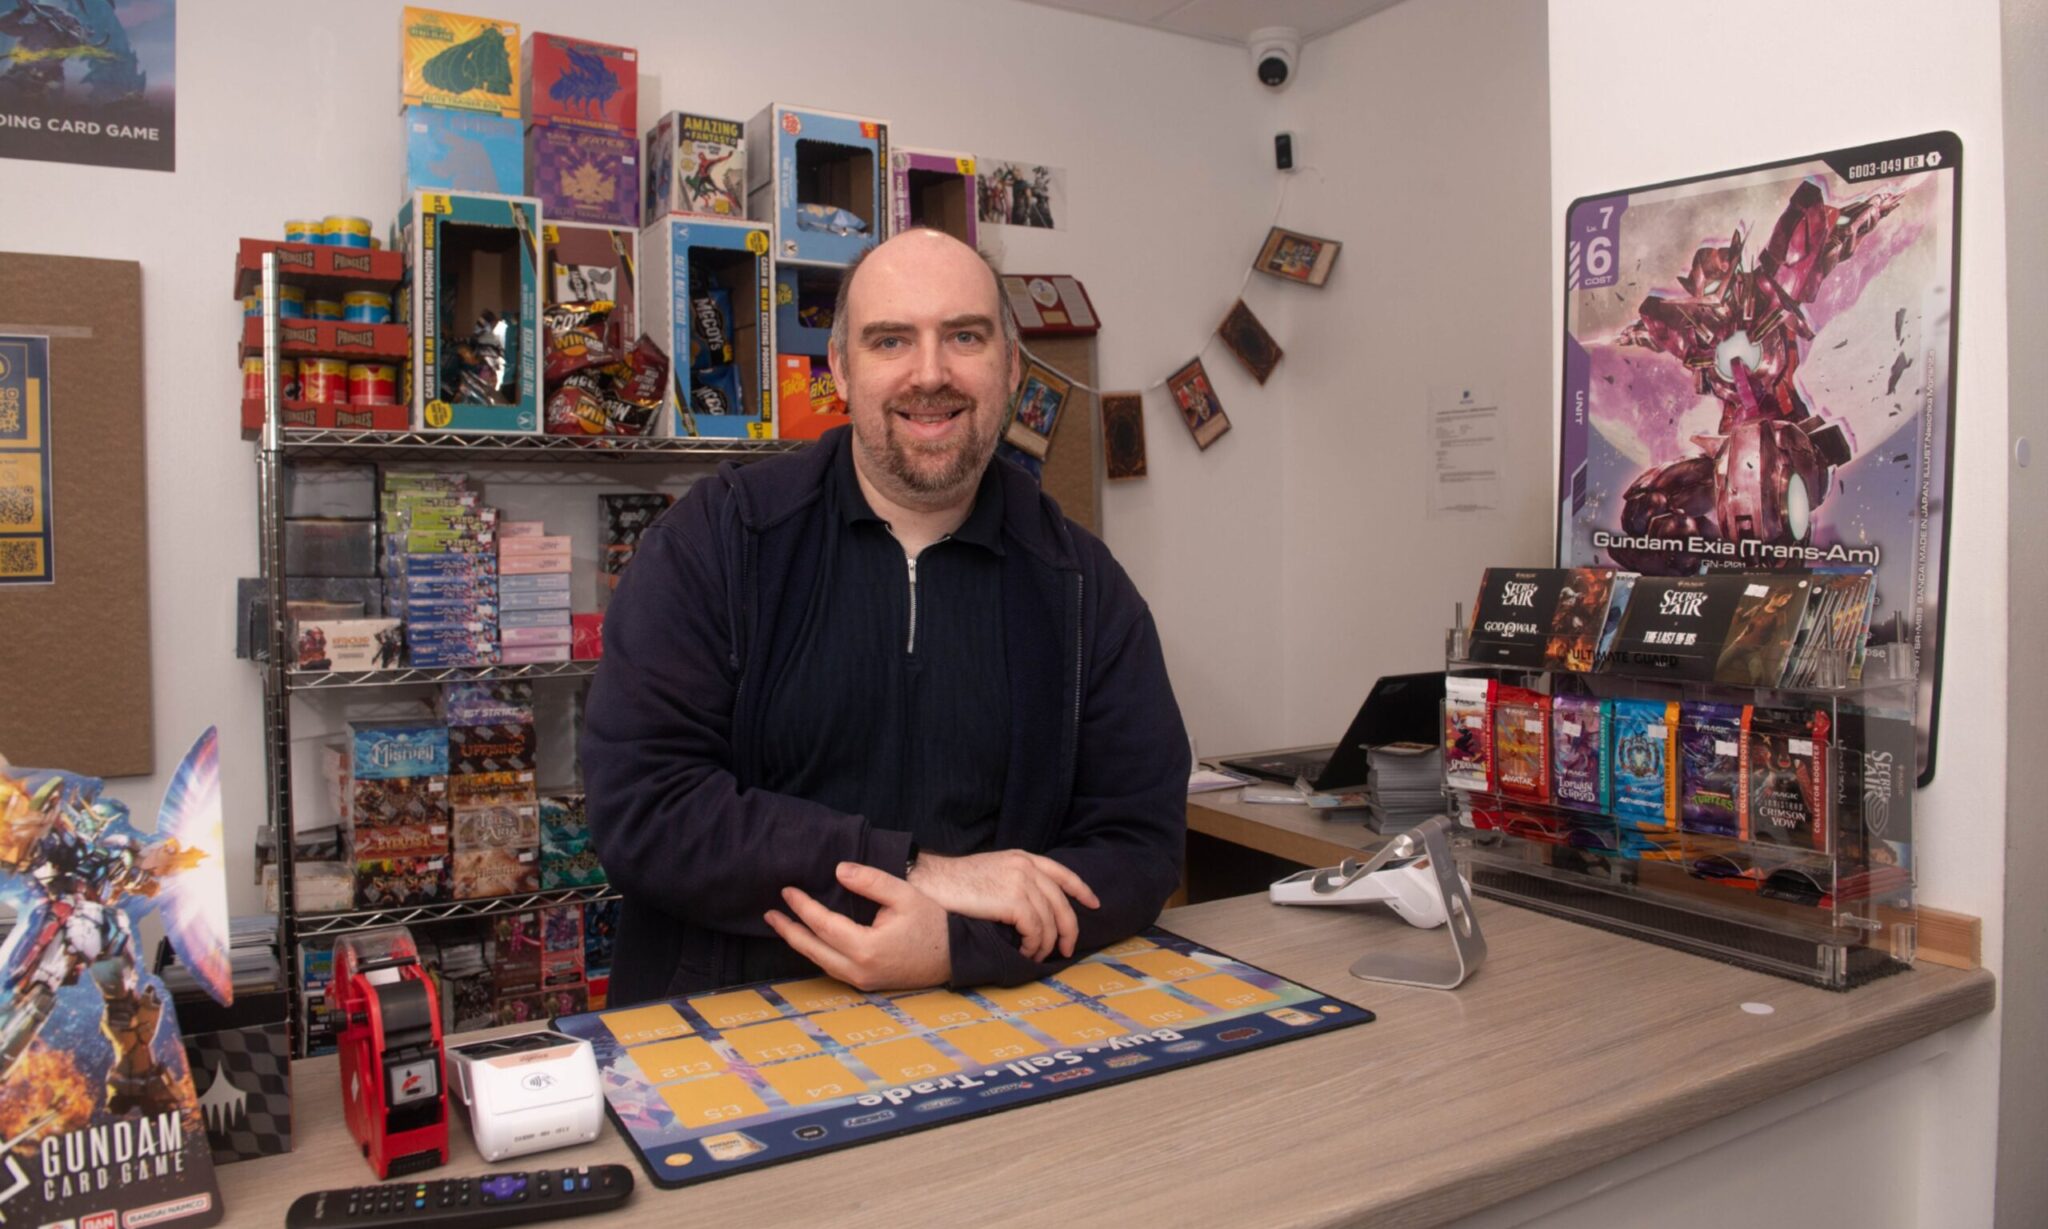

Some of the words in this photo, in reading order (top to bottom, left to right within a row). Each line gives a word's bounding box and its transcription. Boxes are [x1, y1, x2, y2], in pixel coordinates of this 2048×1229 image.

[47, 118, 101, 135] CARD
[106, 124, 160, 141] GAME
[684, 117, 738, 137] AMAZING
[691, 131, 730, 145] FANTASY
[1908, 156, 1919, 168] LR
[1600, 206, 1614, 230] 7
[279, 250, 314, 268] PRINGLES
[334, 254, 371, 272] PRINGLES
[1586, 236, 1612, 276] 6
[425, 250, 435, 298] PROMOTION
[760, 256, 769, 277] CASH
[760, 278, 769, 287] IN
[1584, 275, 1613, 286] COST
[761, 288, 769, 299] ON
[761, 300, 769, 311] AN
[425, 299, 435, 337] EXCITING
[337, 329, 374, 346] PRINGLES
[761, 312, 770, 345] EXCITING
[425, 338, 435, 350] AN
[425, 351, 435, 364] ON
[425, 366, 435, 374] IN
[761, 346, 770, 390] PROMOTION
[425, 375, 435, 399] CASH
[810, 376, 837, 399] akis
[576, 402, 607, 424] WIN
[1575, 390, 1584, 425] UNIT
[337, 411, 373, 428] PRINGLES
[1921, 481, 1929, 517] JAPAN
[1920, 519, 1927, 529] IN
[1593, 531, 1683, 552] Gundam
[1688, 536, 1735, 555] Exia
[1740, 539, 1881, 566] (Trans-Am)
[1919, 530, 1927, 562] MADE
[1502, 581, 1536, 599] SECRET
[1916, 563, 1925, 603] BANDAI
[1502, 590, 1535, 608] LAIR
[1660, 598, 1703, 617] LAIR
[1661, 590, 1705, 608] SECRET
[1484, 621, 1505, 632] GOD
[1516, 623, 1538, 635] WAR
[1643, 631, 1657, 643] THE
[1657, 631, 1673, 644] LAST
[1674, 632, 1683, 645] OF
[1684, 632, 1697, 646] US
[1573, 649, 1630, 664] ULTIMATE
[1633, 653, 1679, 668] GUARD
[1813, 745, 1821, 783] BOOSTER
[1501, 774, 1536, 788] AVATAR
[1872, 750, 1893, 799] SECRET
[1739, 768, 1747, 814] COLLECTOR
[1771, 791, 1799, 800] MAGIC
[1692, 795, 1734, 811] TURTLES
[1759, 806, 1806, 822] CRIMSON
[1771, 817, 1797, 829] VOW
[846, 1025, 895, 1041] £10
[1072, 1025, 1107, 1041] £1
[1107, 1027, 1184, 1052] Buy
[756, 1042, 806, 1059] £11
[989, 1043, 1024, 1059] £2
[658, 1060, 712, 1078] £12
[899, 1063, 936, 1079] £3
[1006, 1049, 1084, 1077] Sell
[805, 1081, 843, 1099] £4
[855, 1073, 984, 1108] Trade
[704, 1103, 742, 1119] £5
[41, 1110, 182, 1178] GUNDAM
[43, 1173, 109, 1201] CARD
[121, 1151, 185, 1184] GAME
[167, 1199, 204, 1214] NAMCO
